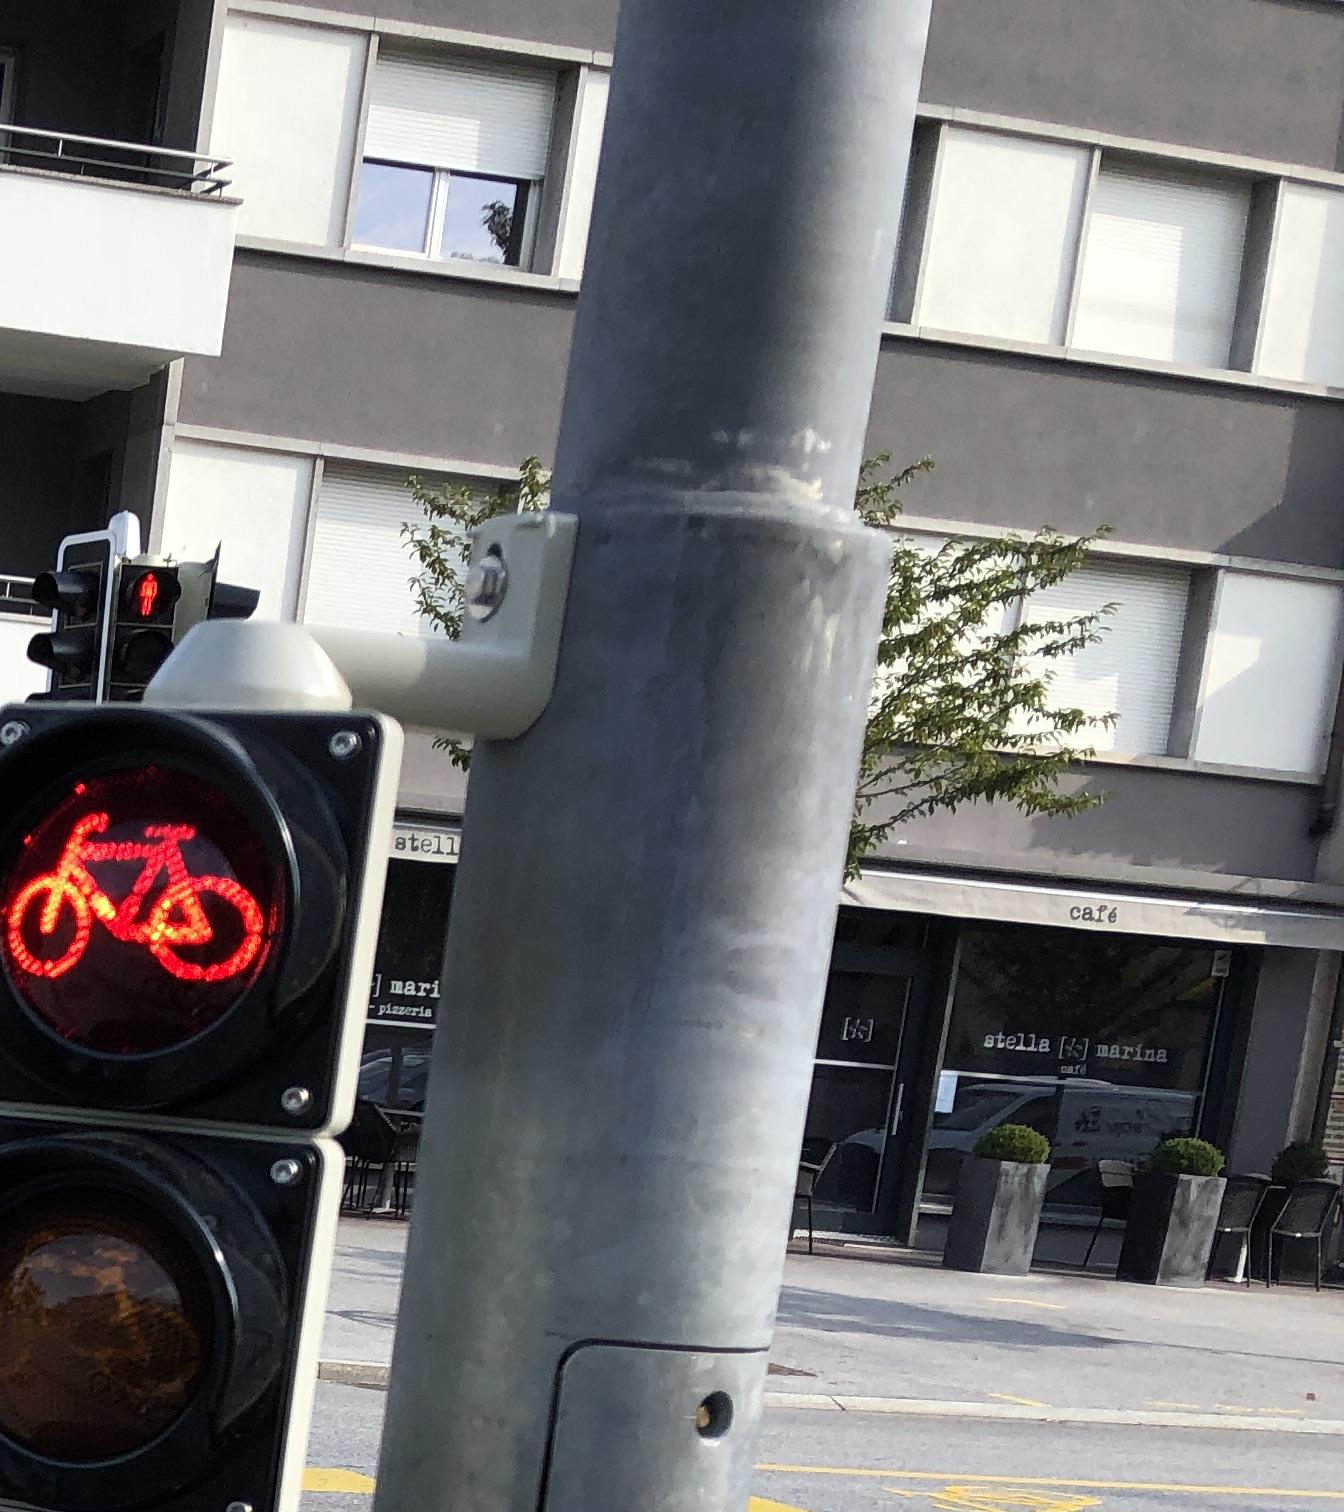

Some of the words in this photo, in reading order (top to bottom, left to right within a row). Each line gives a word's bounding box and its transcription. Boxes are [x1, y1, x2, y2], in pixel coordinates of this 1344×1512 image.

[394, 833, 459, 856] stell
[1069, 903, 1118, 924] café
[389, 978, 441, 998] mari
[377, 1003, 433, 1018] pizzeria
[983, 1032, 1051, 1053] stella
[1096, 1042, 1168, 1064] marina
[1060, 1063, 1088, 1075] café
